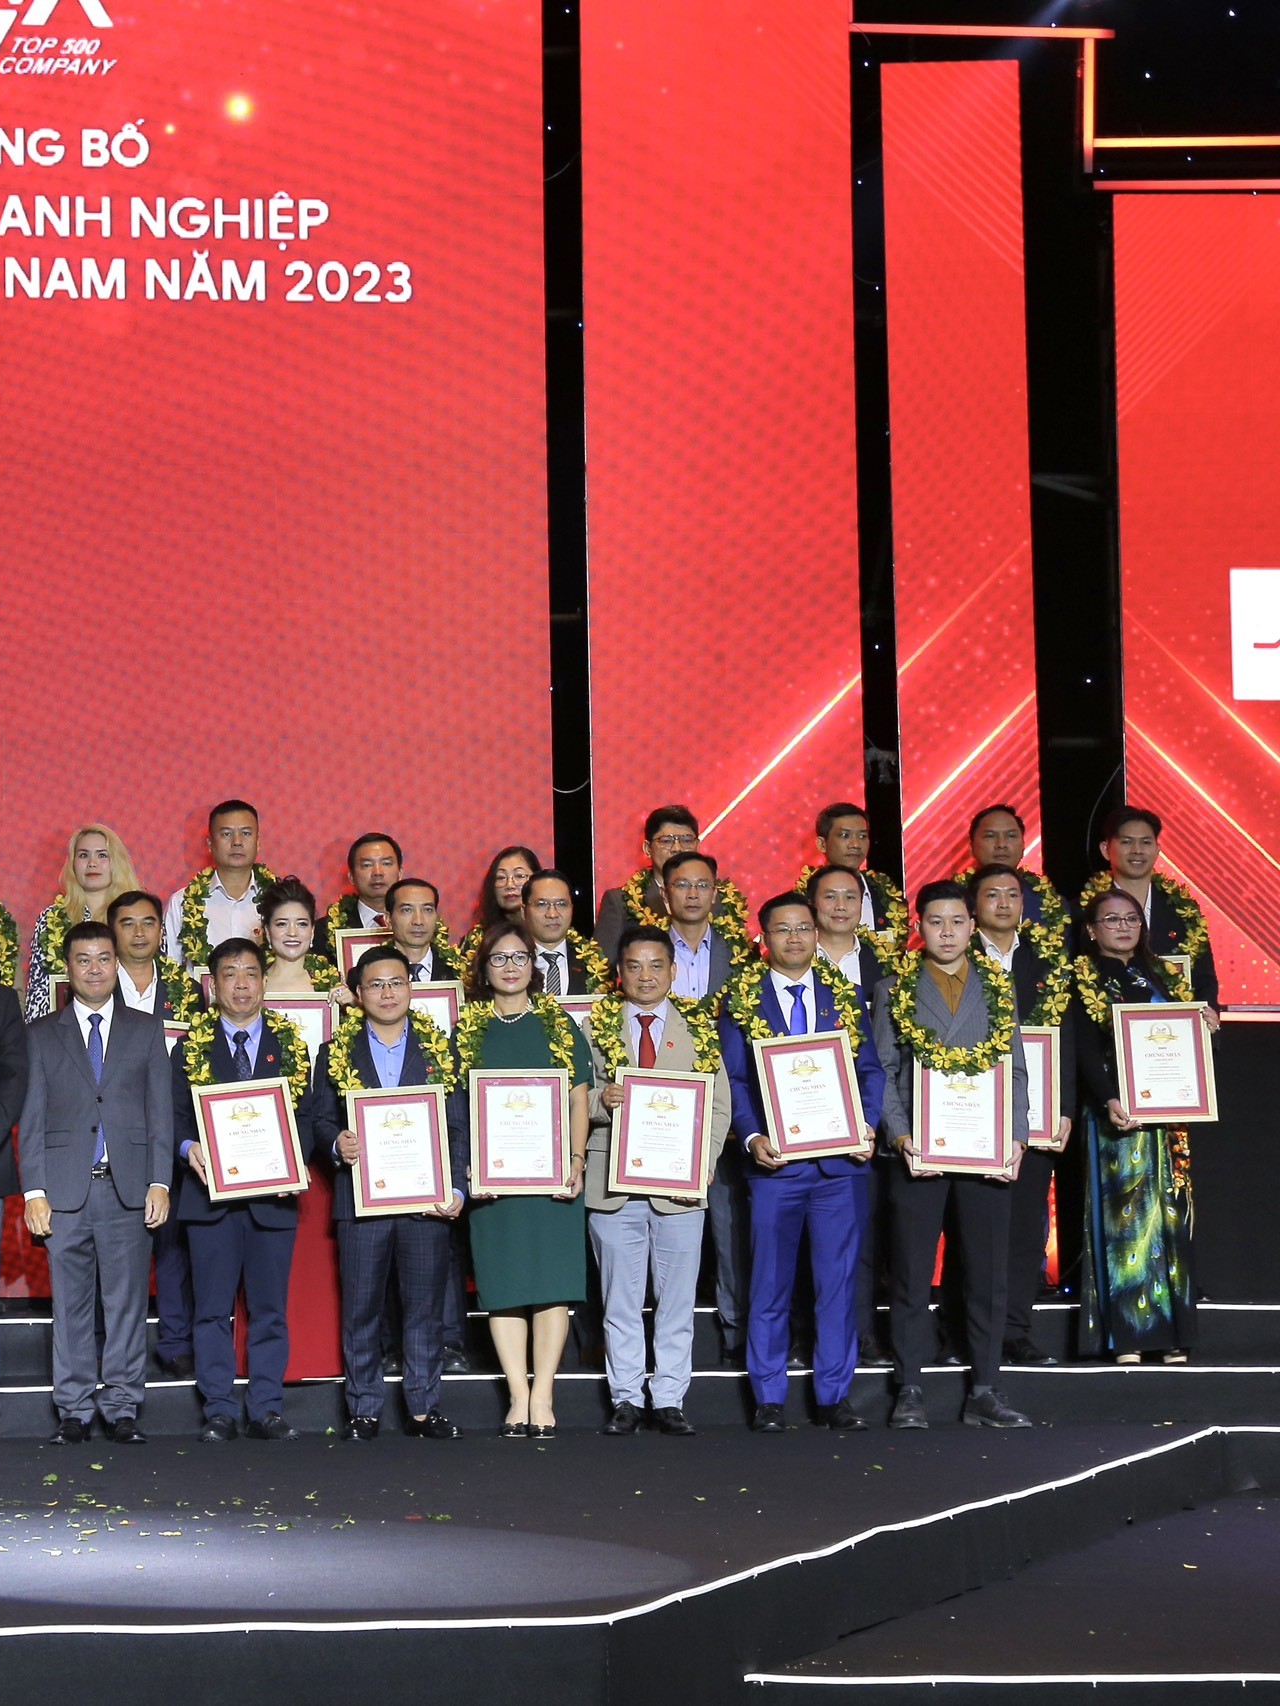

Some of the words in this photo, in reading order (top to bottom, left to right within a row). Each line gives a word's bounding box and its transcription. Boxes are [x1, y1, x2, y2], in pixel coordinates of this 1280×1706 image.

[11, 36, 58, 54] TOP
[59, 37, 102, 56] 500
[81, 118, 150, 168] BỐ
[130, 191, 329, 251] NGHIỆP
[4, 256, 126, 300] NAM
[145, 249, 266, 301] NĂM
[284, 260, 412, 303] 2023
